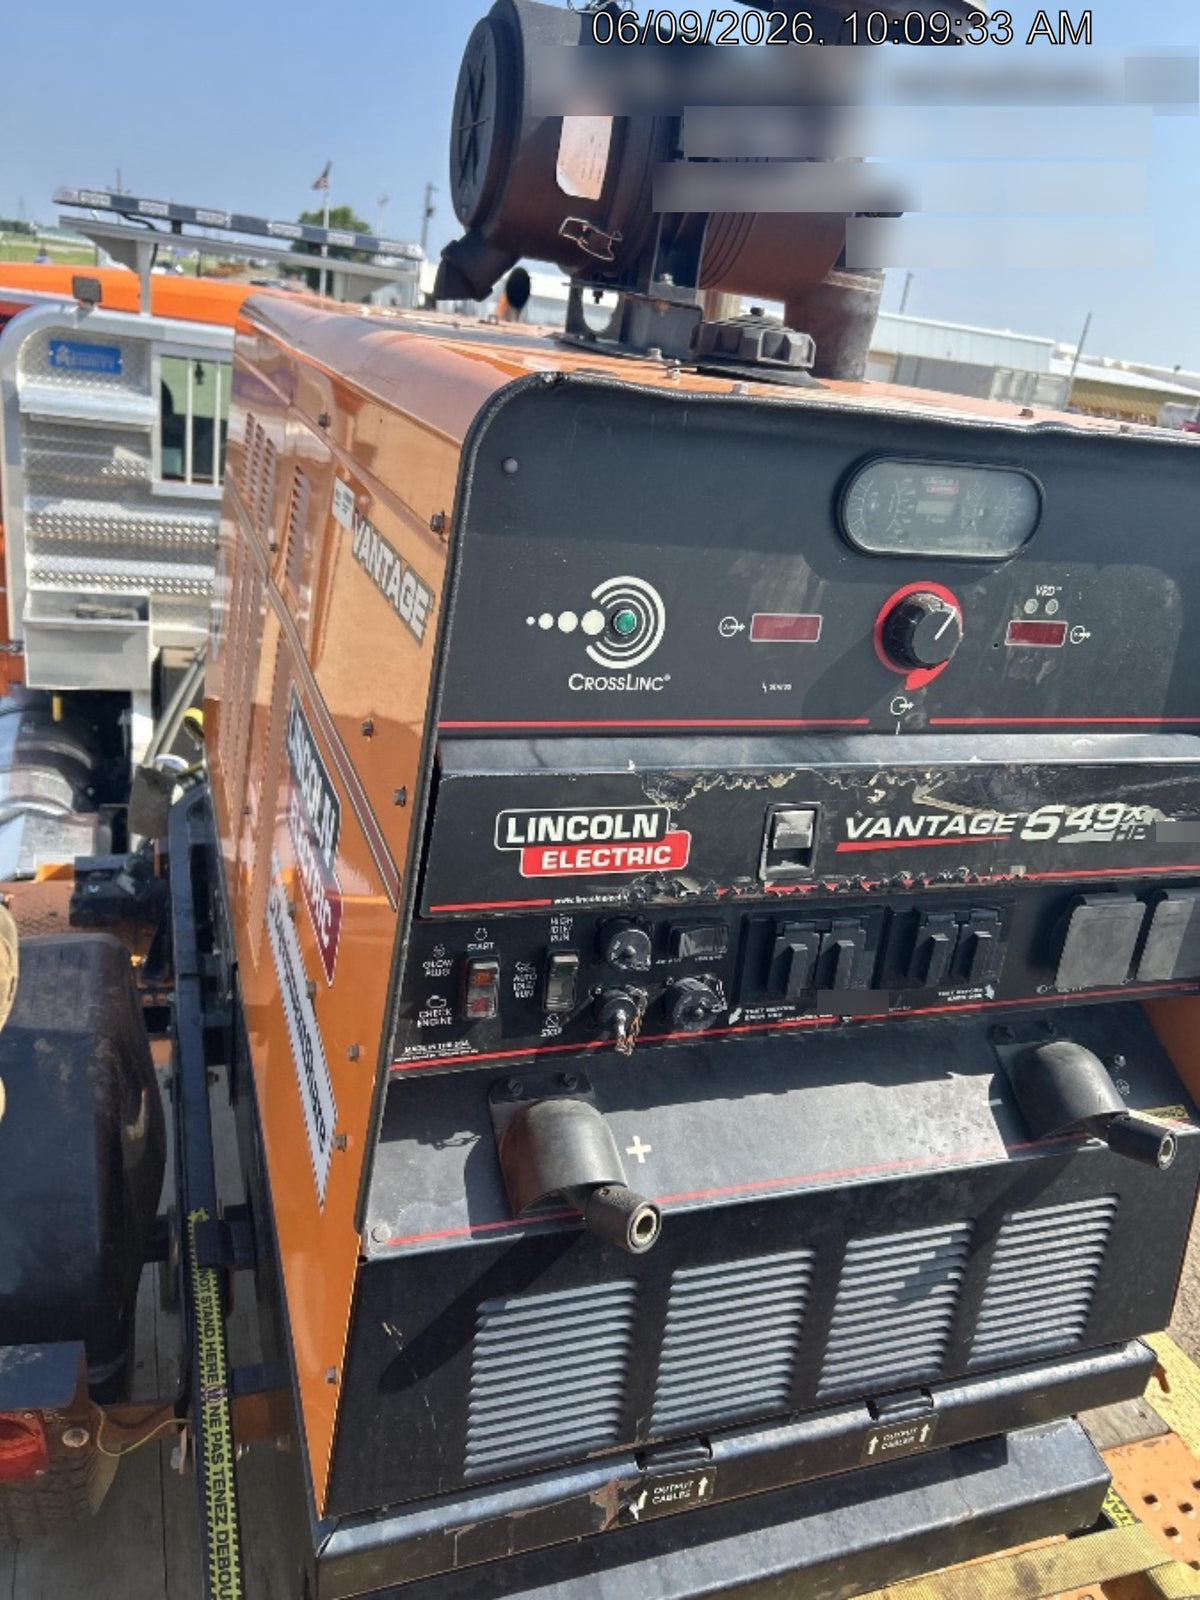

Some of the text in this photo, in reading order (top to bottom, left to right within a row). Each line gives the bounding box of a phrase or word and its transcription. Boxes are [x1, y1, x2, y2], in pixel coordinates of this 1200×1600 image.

[353, 512, 429, 640] VANTAGE
[506, 813, 659, 844] LINCOLN
[846, 813, 1018, 839] VANTAGE
[541, 845, 672, 870] ELECTRIC
[467, 942, 495, 952] START
[423, 959, 453, 970] GLOW
[417, 1017, 452, 1028] ENGINE
[419, 1008, 453, 1019] CHECK
[200, 1269, 218, 1383] NOT STAND HERE
[654, 1480, 694, 1494] OUTPUT
[209, 1405, 234, 1600] NE PAS TENEZ DEBOU
